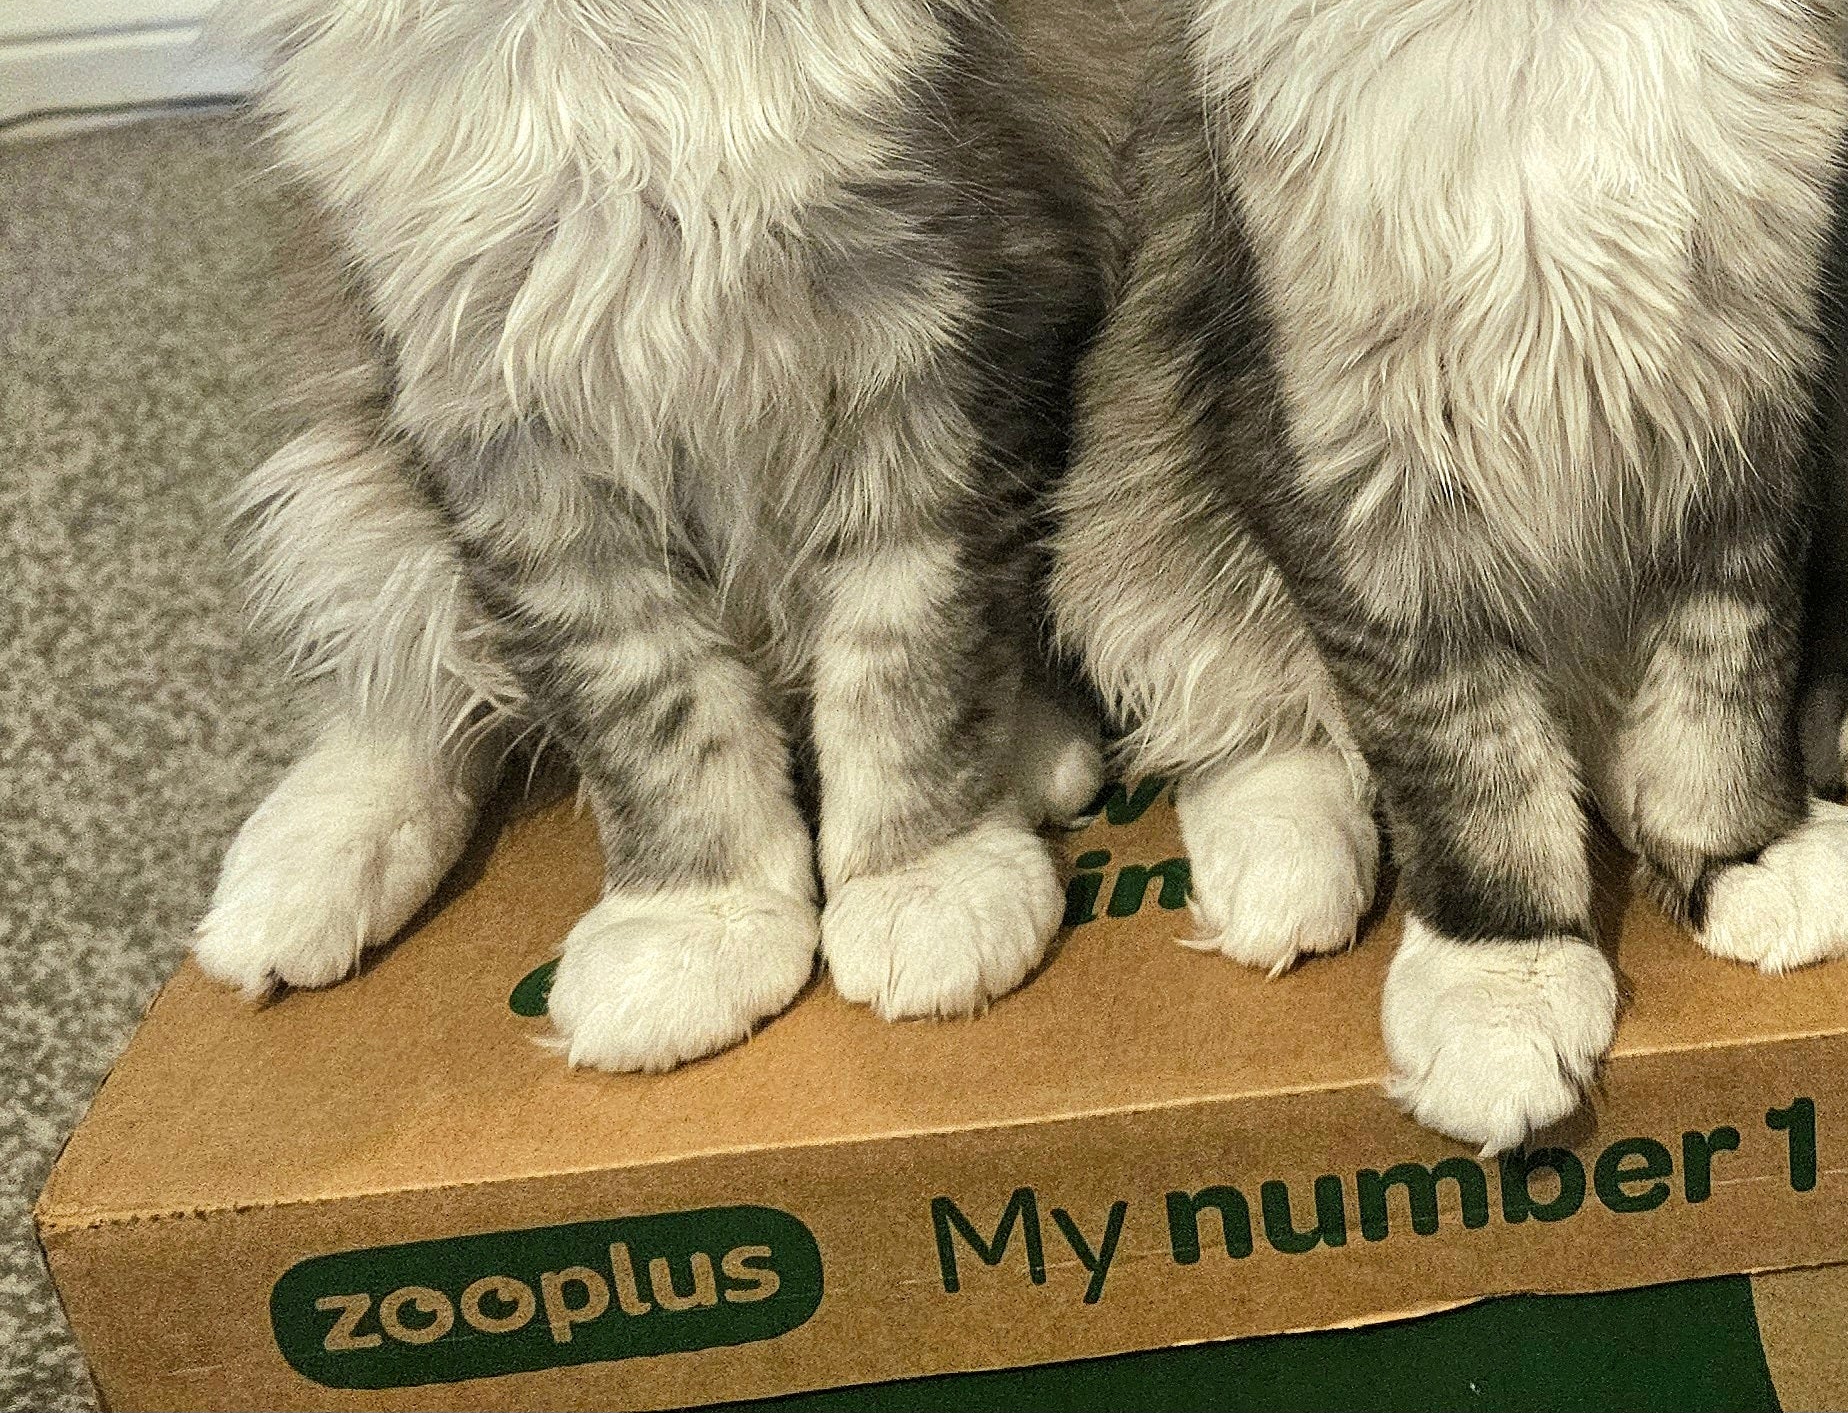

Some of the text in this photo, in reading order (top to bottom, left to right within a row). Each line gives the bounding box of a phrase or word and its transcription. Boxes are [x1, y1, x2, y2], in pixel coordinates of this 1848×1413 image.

[931, 1188, 1127, 1304] My
[1166, 1126, 1741, 1265] number
[1767, 1097, 1818, 1192] 1
[315, 1241, 781, 1352] zooplus
